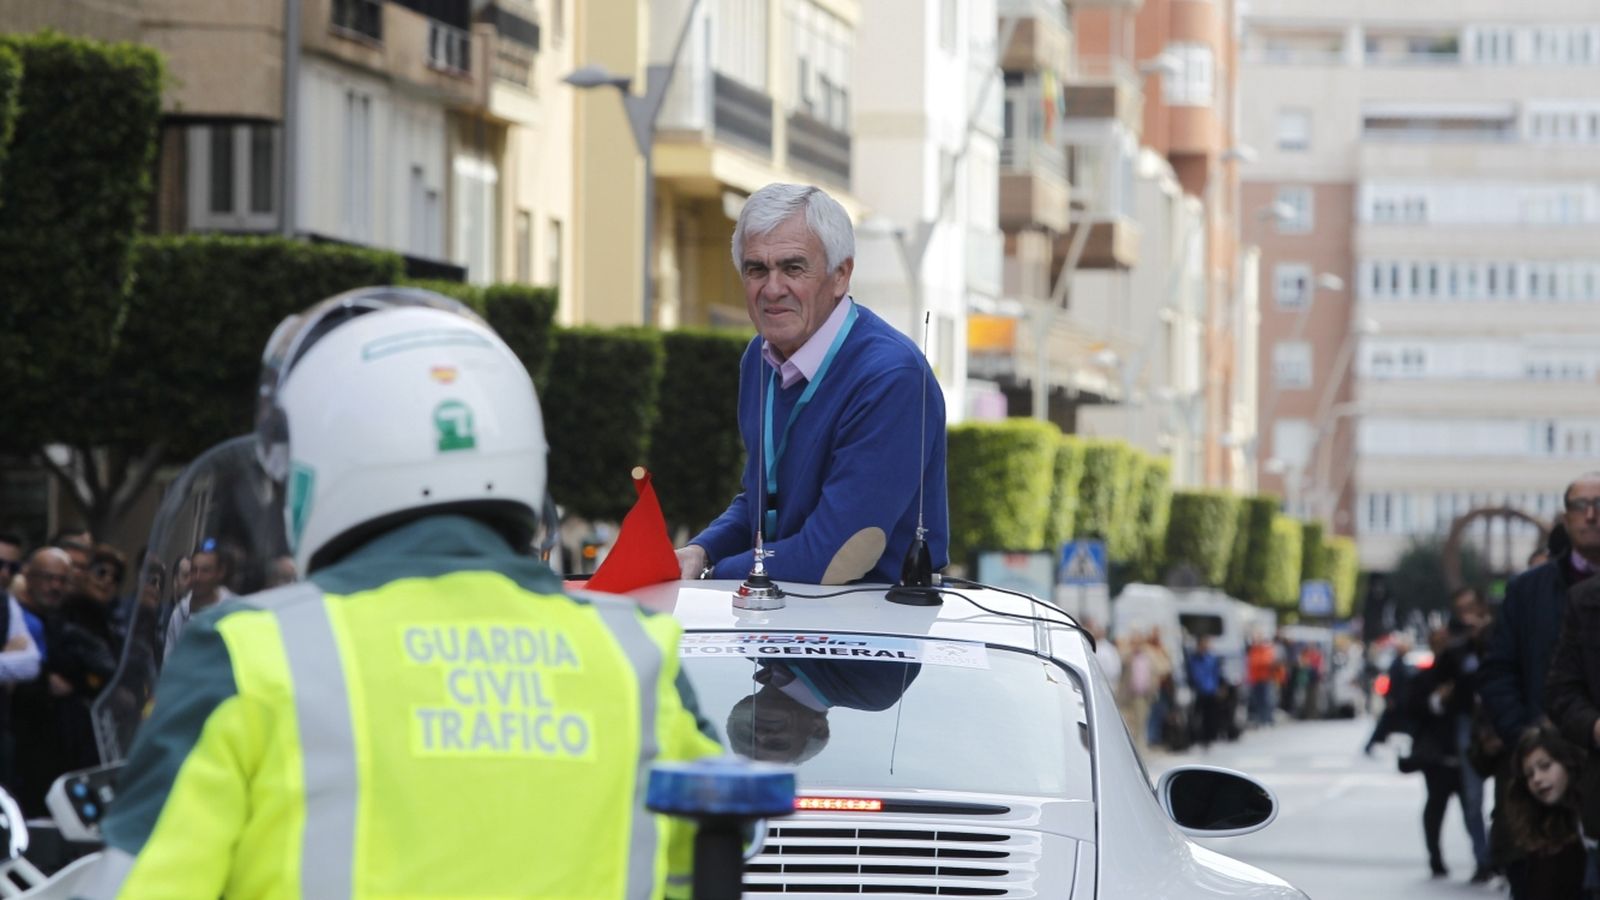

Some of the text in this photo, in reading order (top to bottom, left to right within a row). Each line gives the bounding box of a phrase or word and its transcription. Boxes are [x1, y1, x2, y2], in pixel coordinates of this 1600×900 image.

[403, 626, 579, 668] GUARDIA
[679, 645, 746, 654] TOR
[757, 645, 916, 660] GENERAL
[447, 667, 554, 710] CIVIL
[415, 707, 589, 757] TRAFICO
